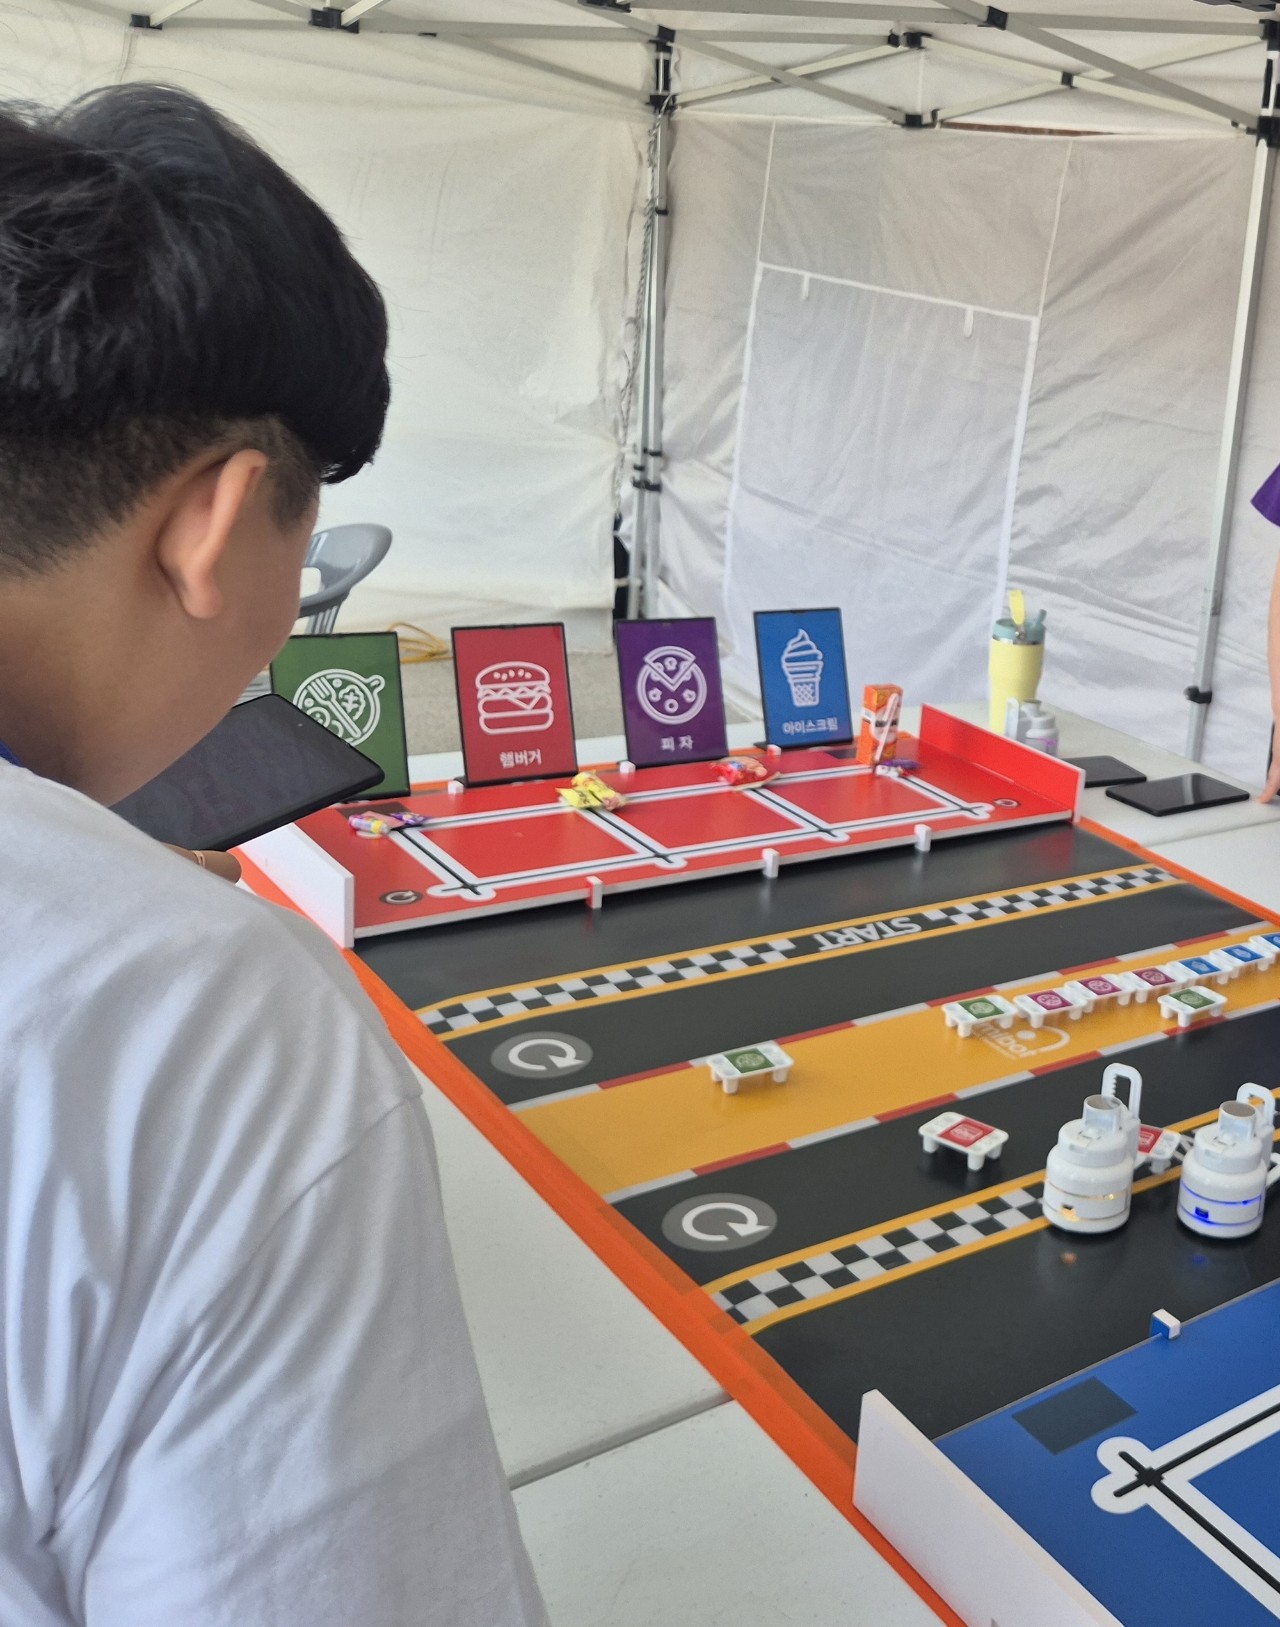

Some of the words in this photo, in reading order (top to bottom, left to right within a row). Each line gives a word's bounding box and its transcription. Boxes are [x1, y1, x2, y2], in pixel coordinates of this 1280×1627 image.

[782, 717, 839, 736] 아이스크림
[499, 748, 542, 769] 햄버거
[812, 916, 923, 952] START
